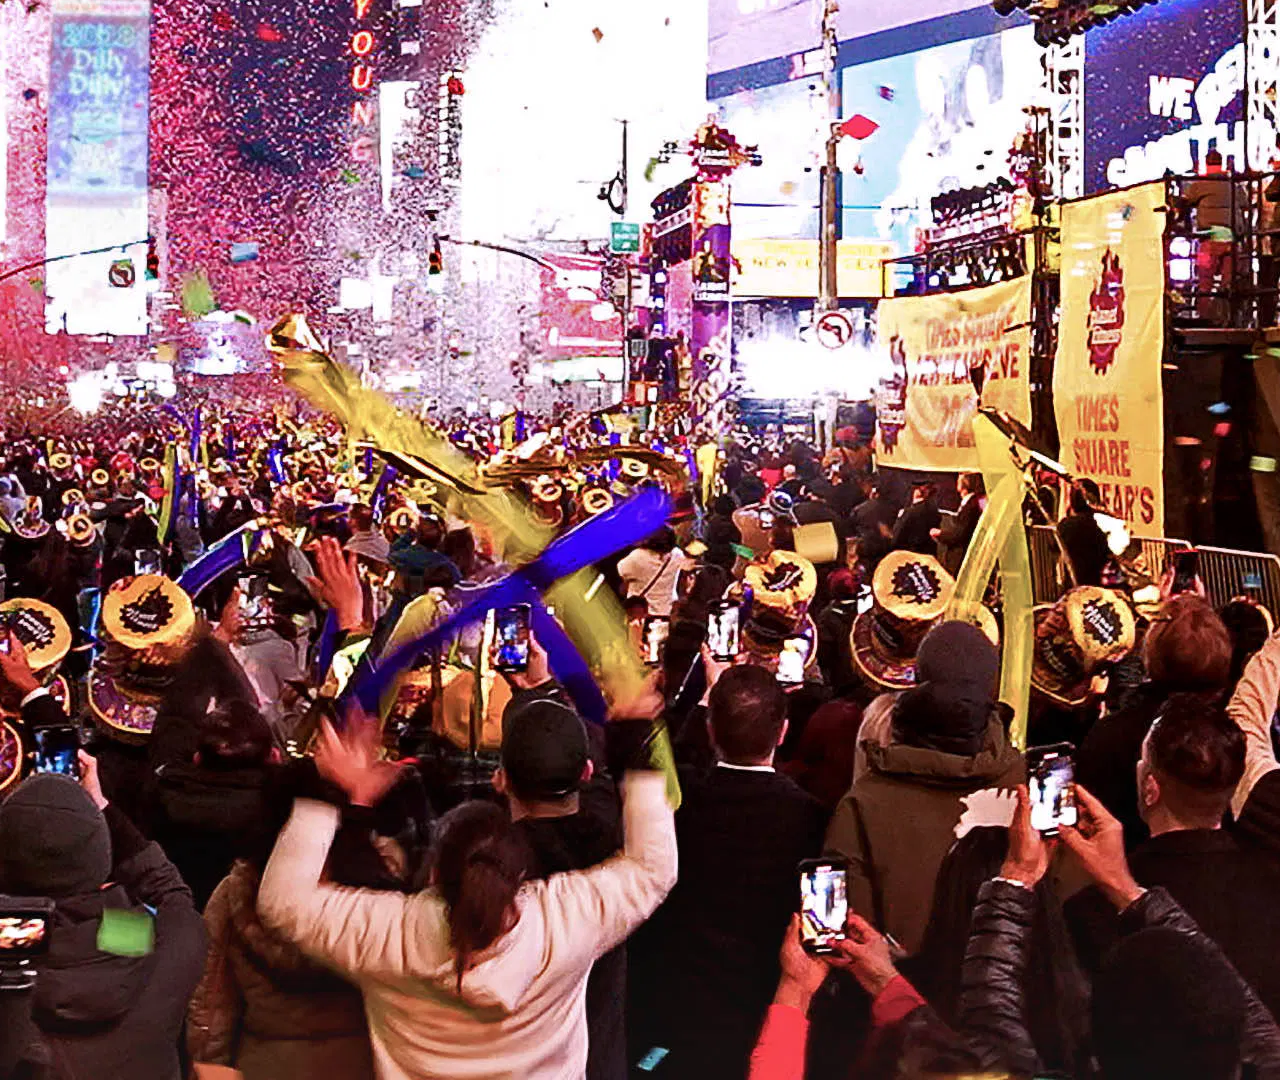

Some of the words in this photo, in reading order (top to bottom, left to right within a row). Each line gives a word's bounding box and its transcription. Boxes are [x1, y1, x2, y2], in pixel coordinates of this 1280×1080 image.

[1148, 74, 1195, 120] WE
[1074, 394, 1120, 433] TIMES
[1073, 439, 1131, 478] SQUARE
